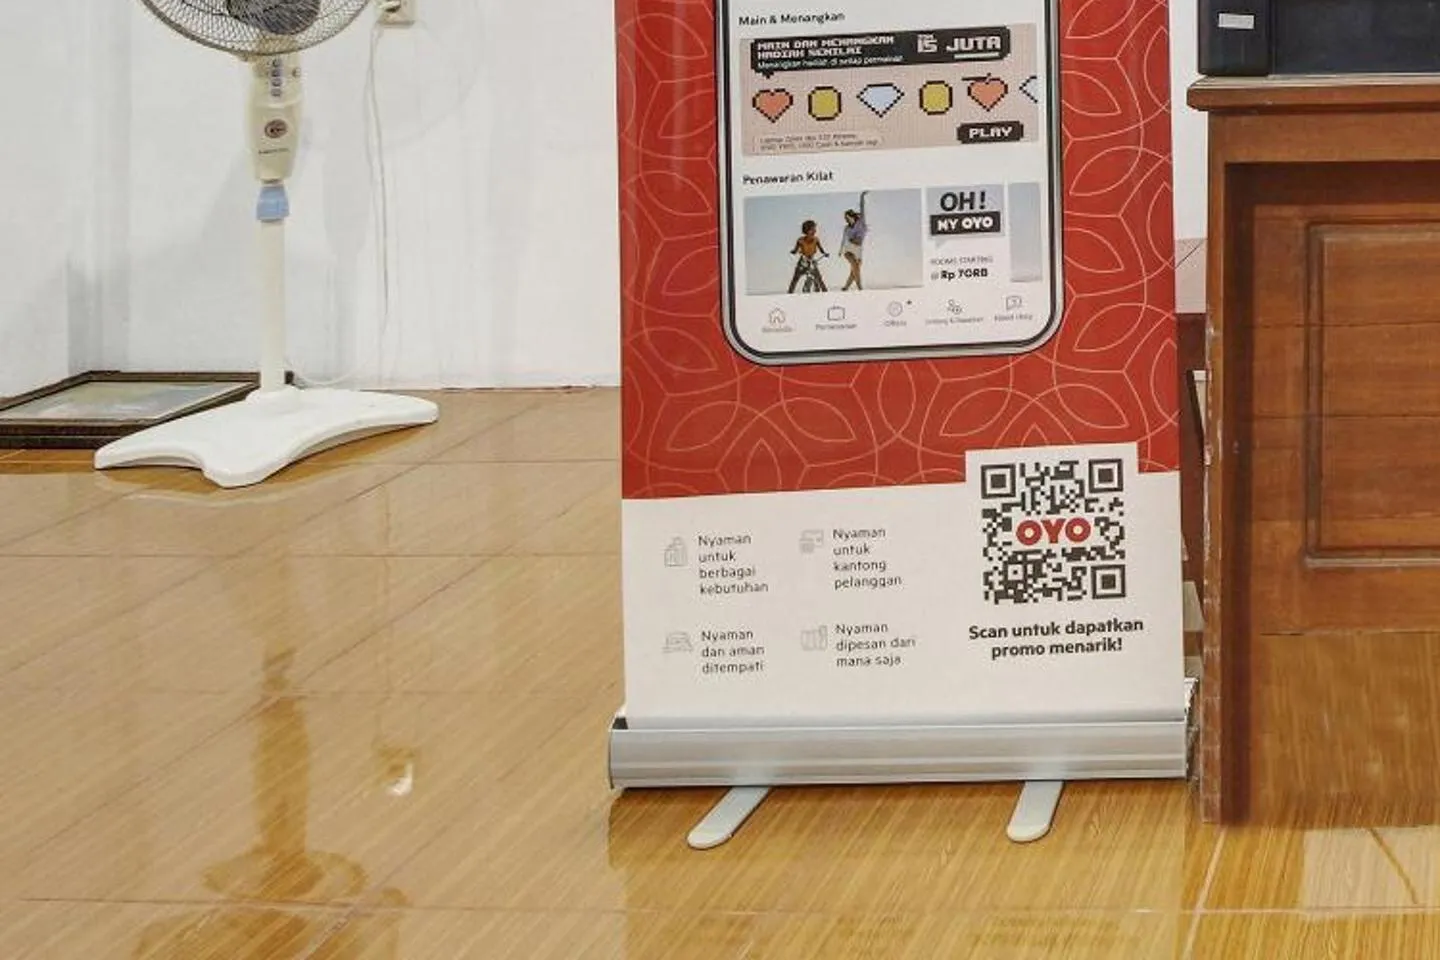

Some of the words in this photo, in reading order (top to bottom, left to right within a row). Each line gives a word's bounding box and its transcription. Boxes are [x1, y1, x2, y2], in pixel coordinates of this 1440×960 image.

[738, 14, 767, 26] Main
[769, 14, 777, 25] &
[781, 11, 846, 25] Menangkan
[946, 35, 1001, 52] JUTA
[969, 126, 1013, 139] PLAY
[743, 173, 804, 186] Penawaran
[806, 171, 834, 183] Kilat
[937, 218, 958, 232] MY
[961, 216, 993, 229] OYO
[941, 269, 955, 281] Rp
[832, 528, 886, 541] Nyaman
[1015, 517, 1092, 546] OYO
[698, 534, 751, 549] Nyaman
[698, 550, 737, 563] untuk
[833, 543, 871, 556] untuk
[699, 566, 756, 581] berbagai
[834, 559, 887, 573] kantong
[700, 582, 769, 596] kebutuhan
[834, 575, 902, 590] pelanggan
[701, 629, 754, 643] Nyaman
[835, 623, 889, 637] Nyaman
[968, 624, 1008, 640] Scan
[1012, 621, 1061, 637] untuk
[1065, 617, 1144, 637] dapatkan
[702, 645, 726, 658] dan
[729, 644, 765, 657] aman
[836, 637, 887, 652] dipesan
[991, 643, 1046, 661] promo
[1049, 636, 1122, 655] menarik!
[702, 660, 764, 675] ditempati
[836, 655, 872, 668] mana
[875, 654, 902, 668] saja
